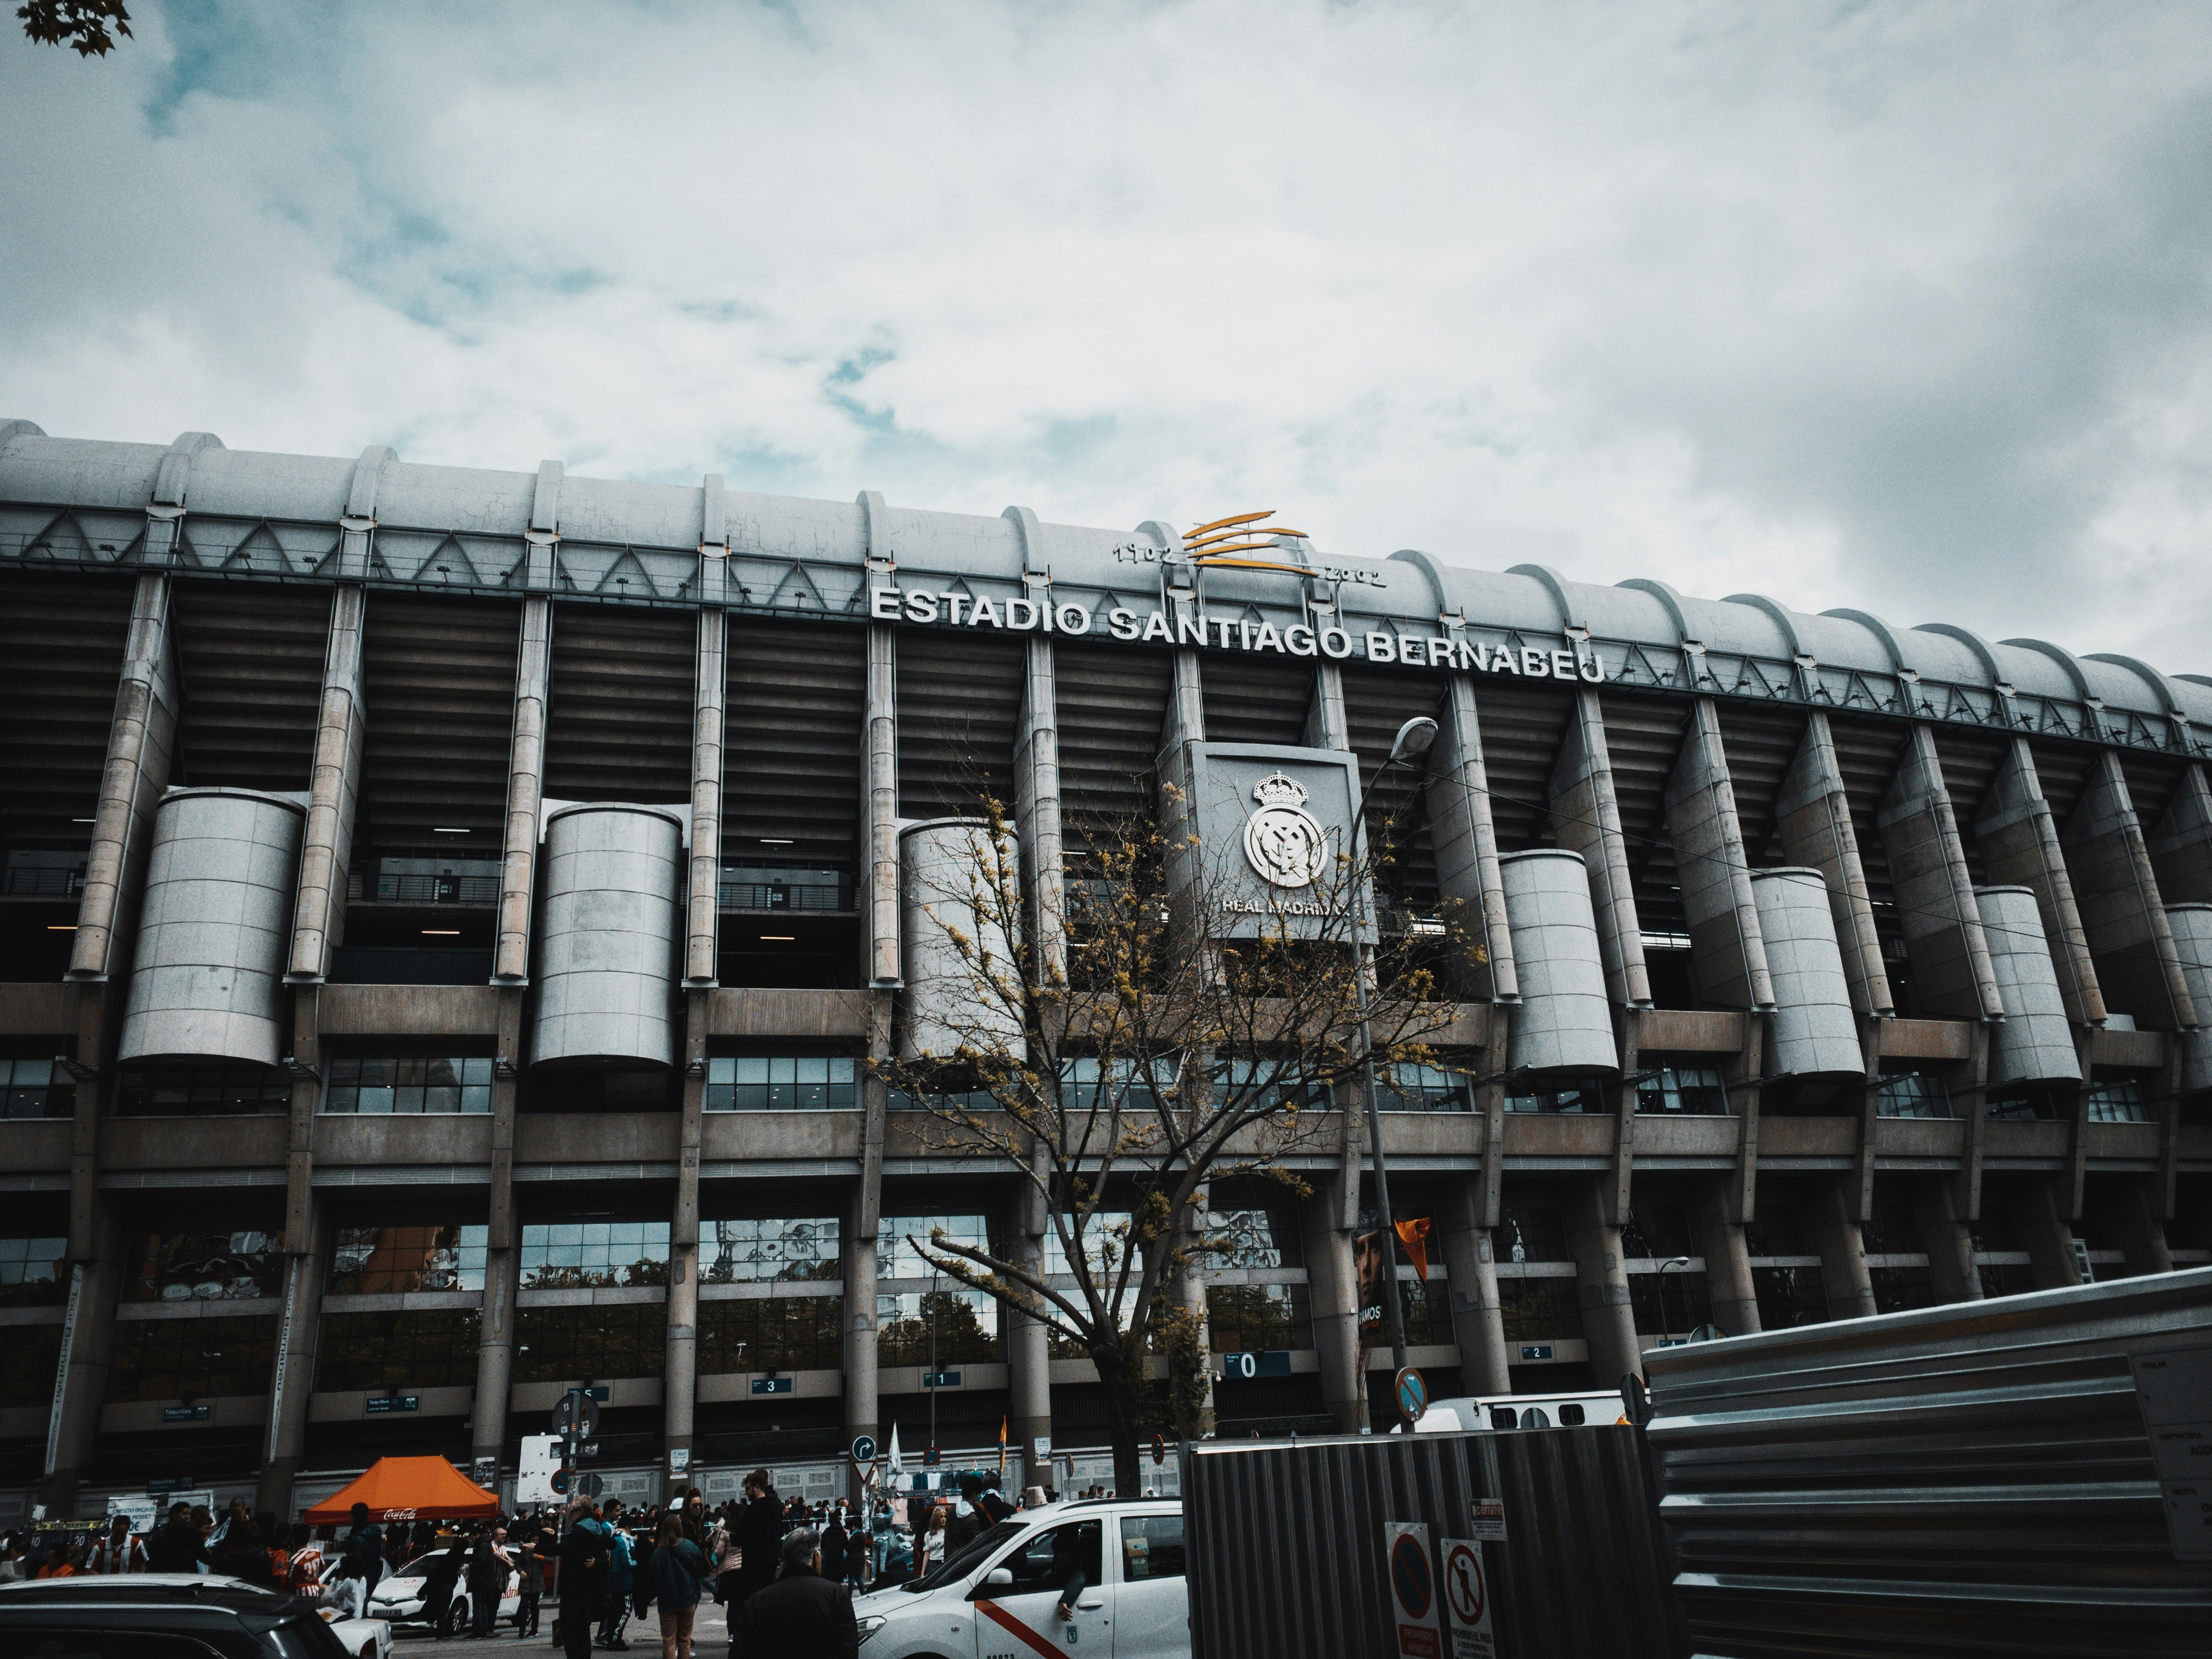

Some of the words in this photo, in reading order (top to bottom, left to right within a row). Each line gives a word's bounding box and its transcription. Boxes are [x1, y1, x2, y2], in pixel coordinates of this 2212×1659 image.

[1113, 540, 1178, 566] 1902
[1324, 565, 1387, 588] 2002
[871, 586, 1091, 636] ESTADIO
[1108, 606, 1352, 659] SANTIAGO
[1364, 630, 1605, 684] BERNABEU
[1222, 899, 1263, 913] REAL
[1268, 900, 1330, 916] MADRID
[66, 1292, 78, 1323] Tour
[1534, 1347, 1540, 1357] 2
[1241, 1353, 1256, 1378] 0
[2141, 1361, 2167, 1369] TITULAR
[768, 1380, 775, 1391] 3
[939, 1373, 944, 1384] 1
[2159, 1432, 2202, 1441] CONTRATISTA
[1404, 1628, 1434, 1641] PROHIBIDO
[1452, 1627, 1474, 1640] PROHIBIDO
[1474, 1632, 1480, 1641] EL
[1480, 1633, 1492, 1644] PASO
[1408, 1643, 1434, 1656] APARCAR
